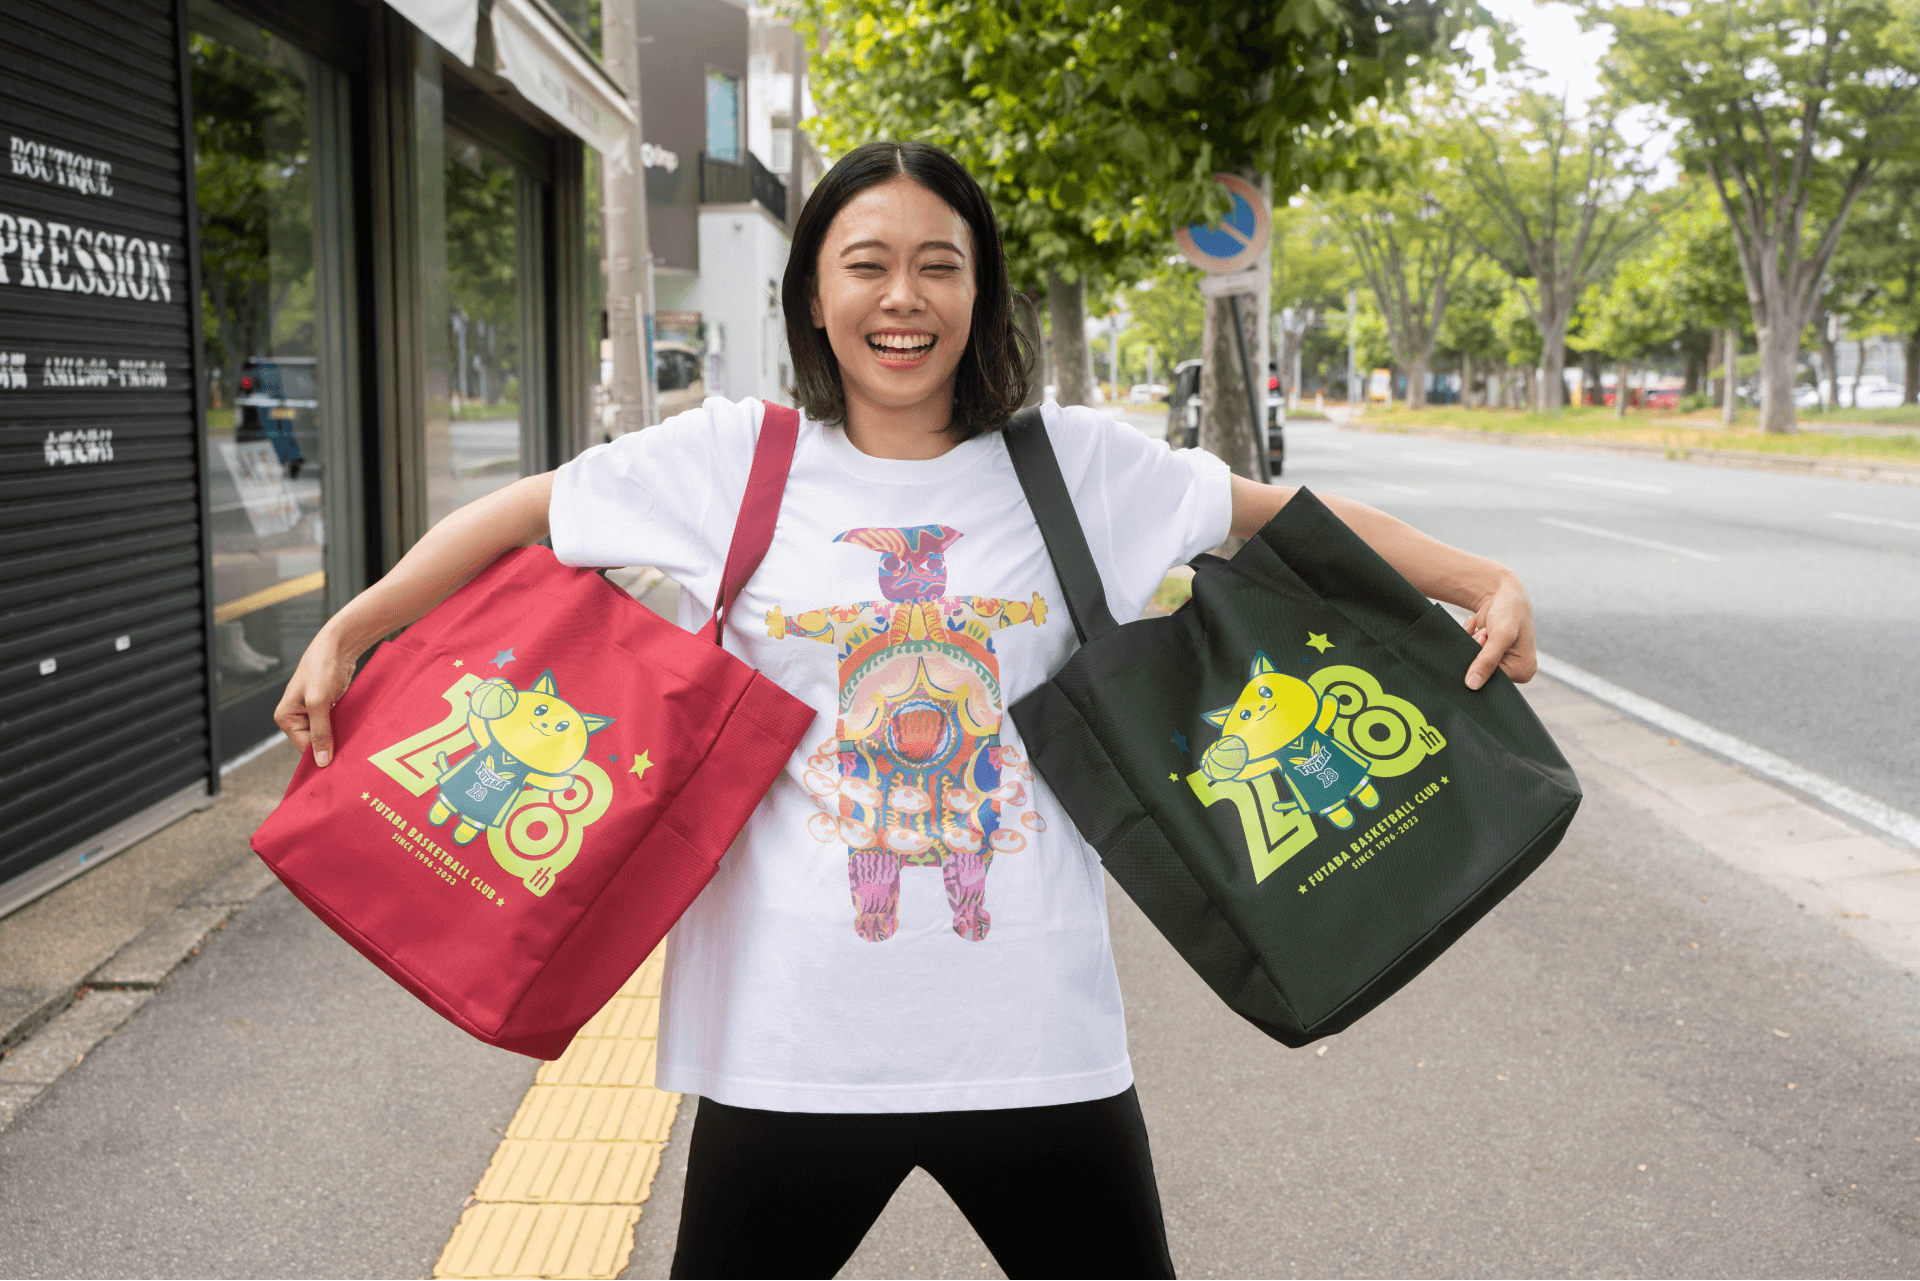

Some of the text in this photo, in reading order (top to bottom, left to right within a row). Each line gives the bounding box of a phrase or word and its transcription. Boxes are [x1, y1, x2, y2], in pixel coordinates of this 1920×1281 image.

[10, 136, 113, 196] BOUTIQUE
[475, 760, 511, 791] FUTABA
[1293, 745, 1332, 776] FUTABA
[1316, 767, 1339, 789] 28
[465, 781, 488, 802] 28
[369, 797, 497, 900] FUTABA BASKETBALL CLUB
[391, 832, 457, 886] SINCE 1996-2023
[1307, 782, 1440, 887] FUTABA BASKETBALL CLUB
[1351, 815, 1420, 870] SINCE 1996-2023
